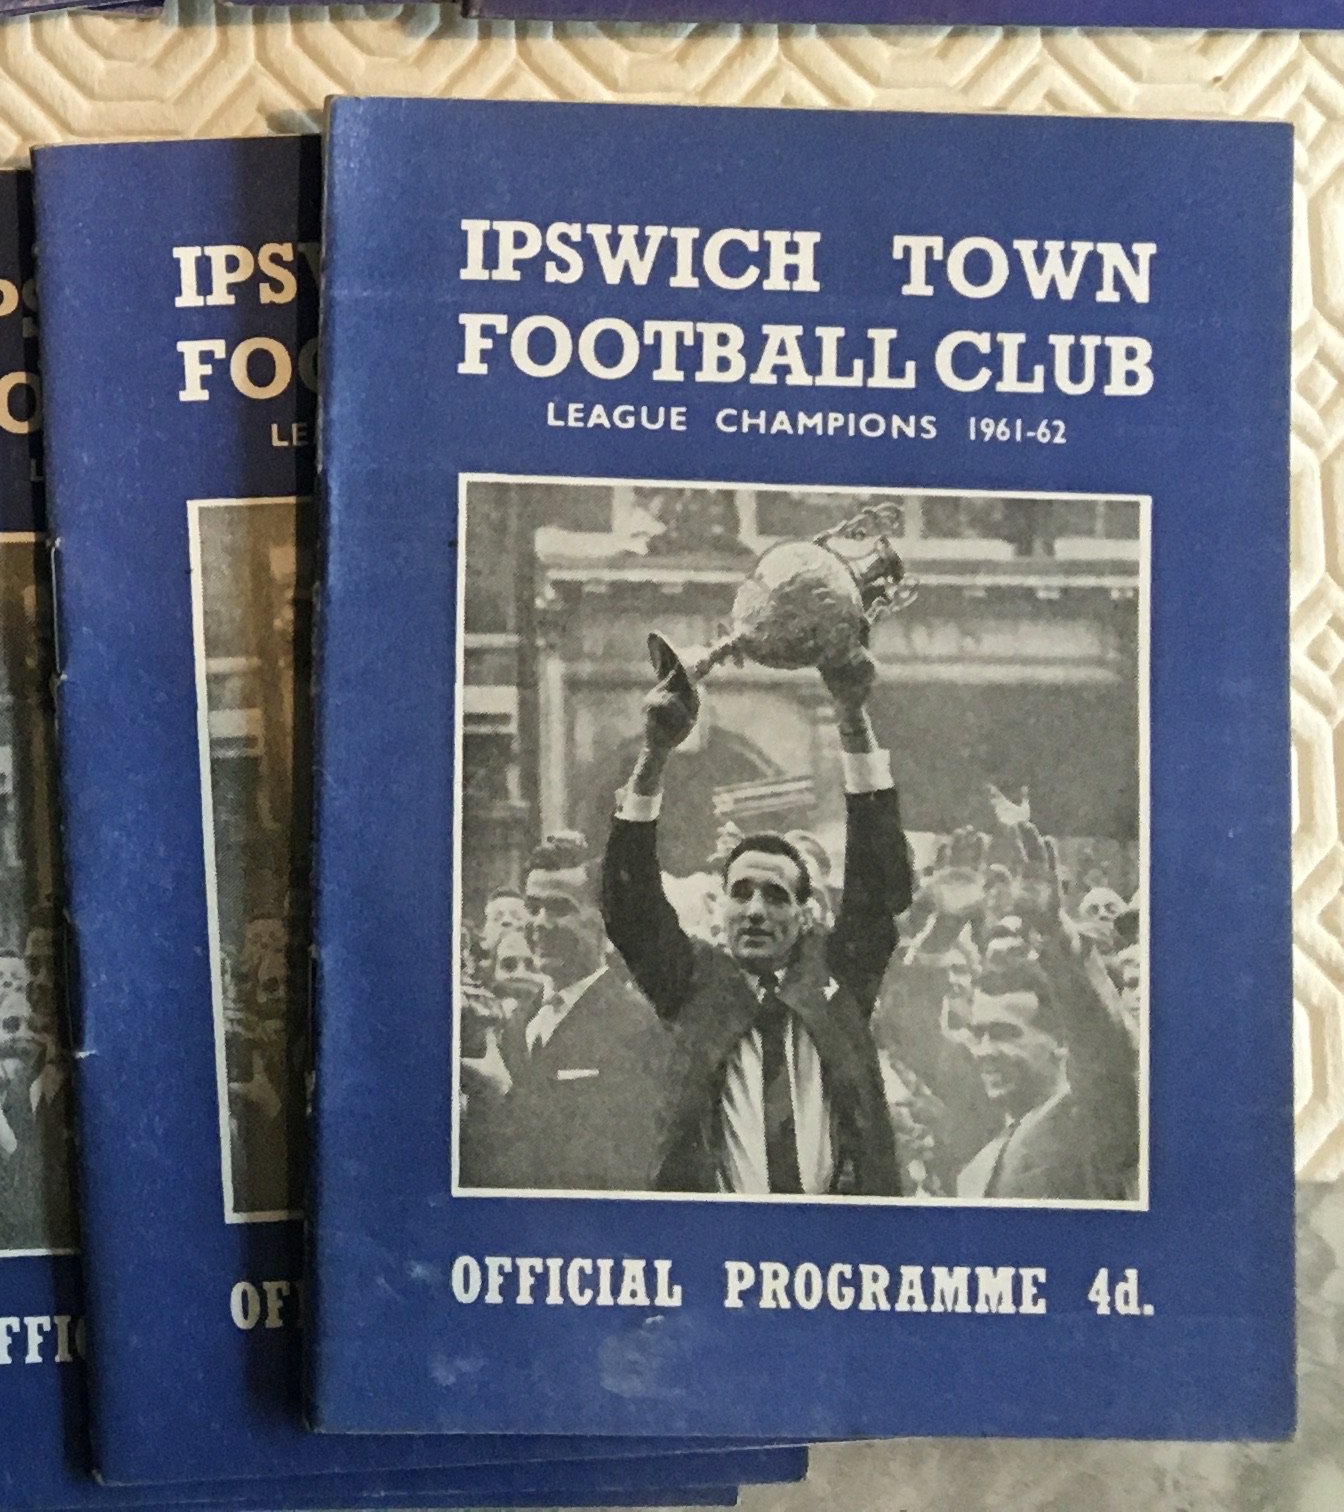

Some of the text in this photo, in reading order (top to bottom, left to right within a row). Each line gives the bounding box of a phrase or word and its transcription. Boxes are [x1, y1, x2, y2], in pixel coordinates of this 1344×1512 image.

[460, 218, 1158, 303] IPSWICH TOWN
[457, 313, 1154, 397] FOOTBALL CLUB
[547, 401, 1068, 445] LEAGUE CHAMPIONS 1961-62
[451, 1254, 1155, 1317] OFFICIAL PROGRAMME 4d.
